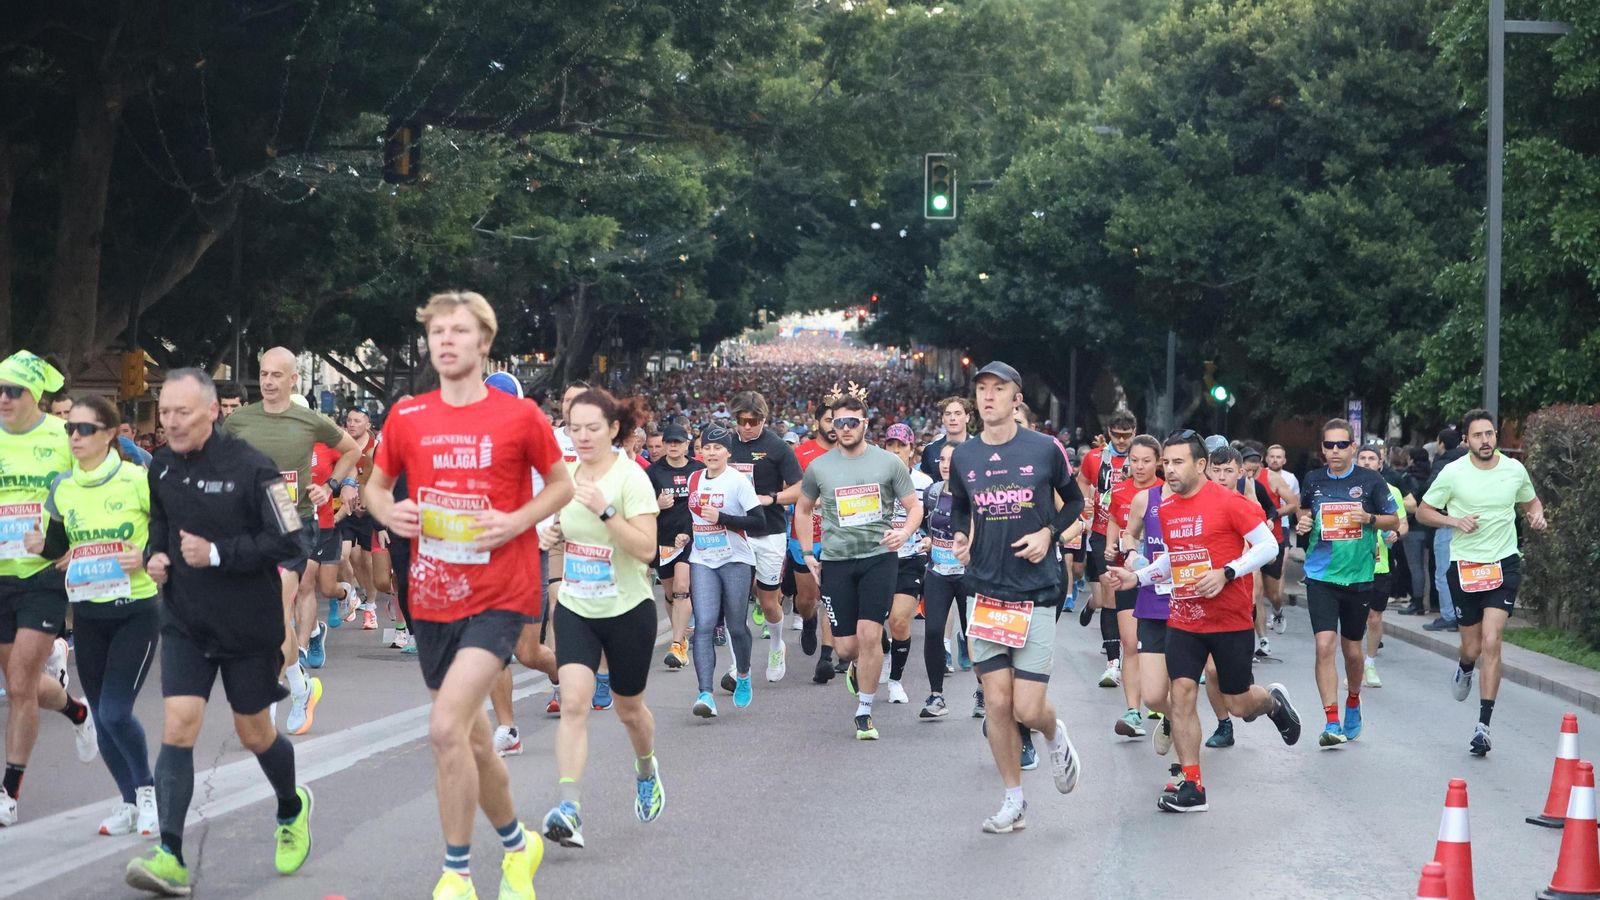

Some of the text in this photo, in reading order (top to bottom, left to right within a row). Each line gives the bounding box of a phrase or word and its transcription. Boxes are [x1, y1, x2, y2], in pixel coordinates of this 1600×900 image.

[432, 434, 477, 445] GENERALI
[433, 452, 477, 469] MÁLAGA
[974, 489, 1034, 507] MADRID
[1175, 553, 1206, 563] GENERALI
[1179, 567, 1196, 578] 587
[988, 611, 1016, 624] 4867
